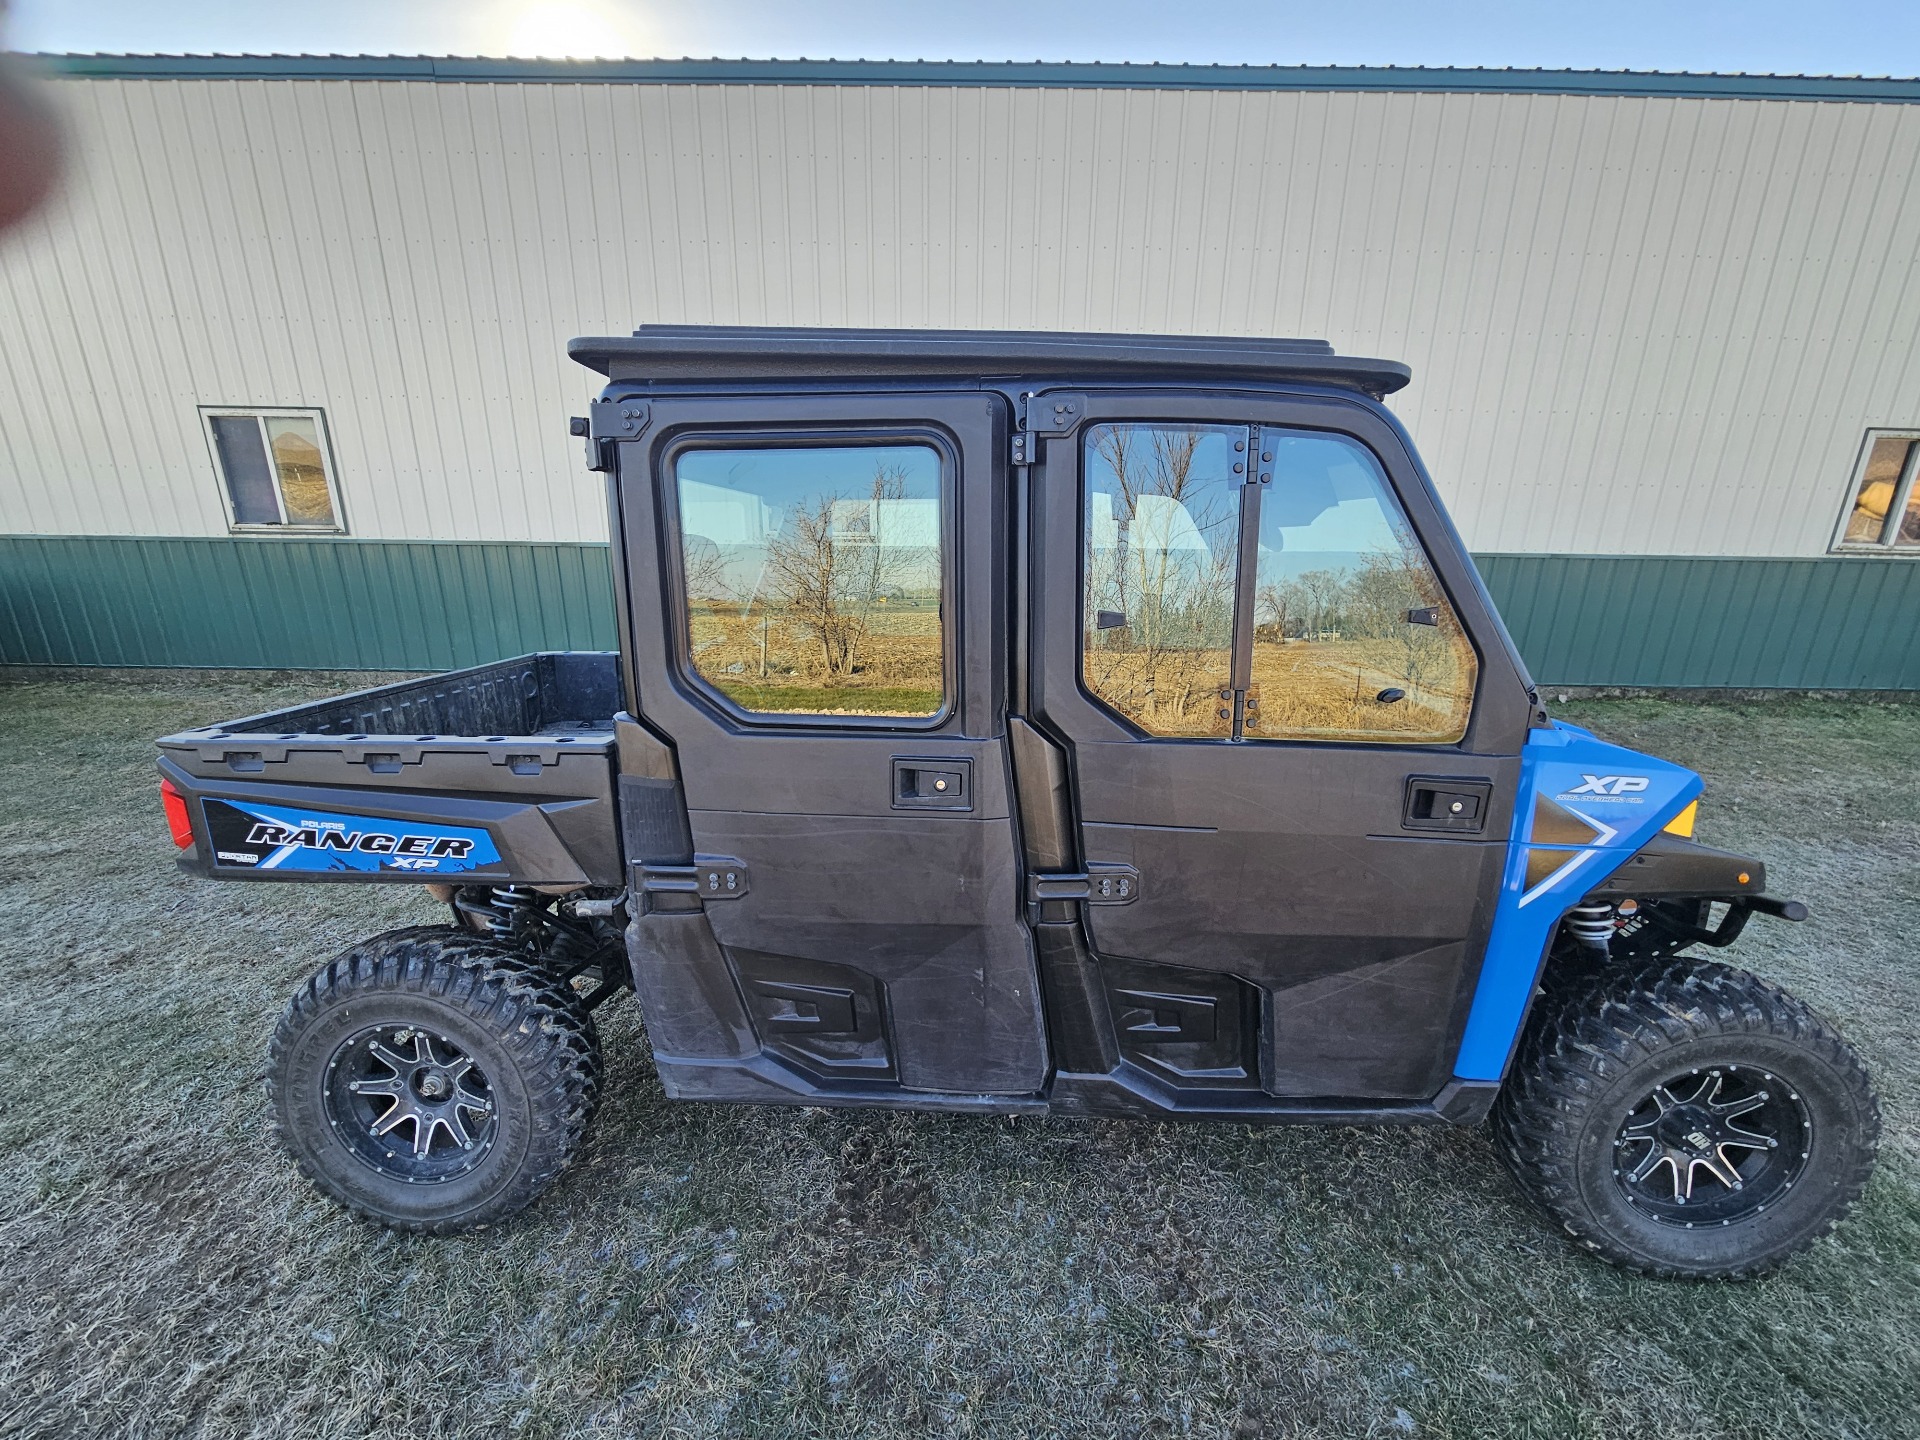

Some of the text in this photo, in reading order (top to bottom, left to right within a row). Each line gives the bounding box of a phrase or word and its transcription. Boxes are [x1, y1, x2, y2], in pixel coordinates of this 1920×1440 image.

[1566, 774, 1650, 795] XP
[300, 820, 346, 831] POLARIS
[245, 823, 475, 859] RANGER
[389, 857, 440, 869] XP
